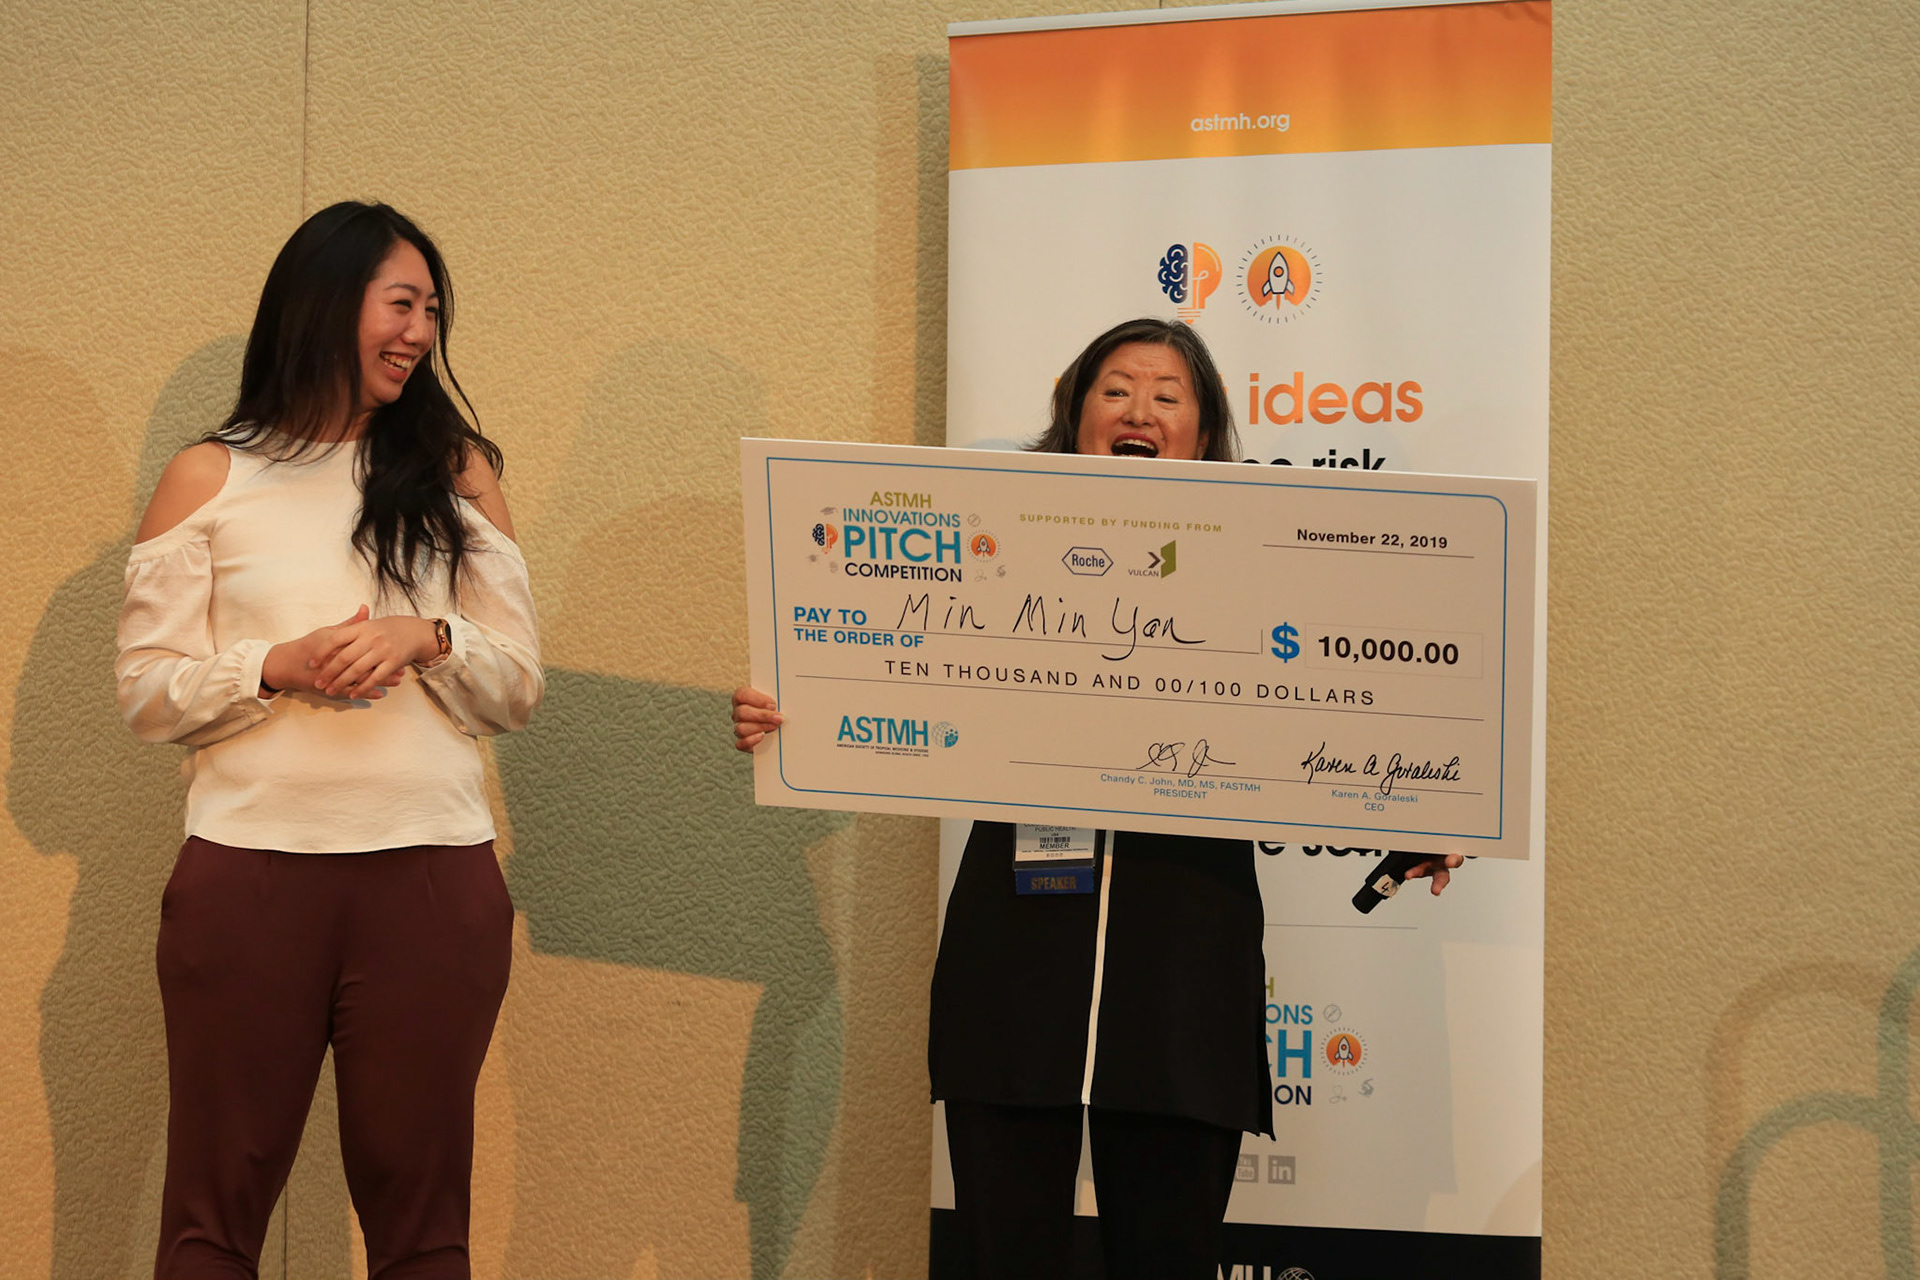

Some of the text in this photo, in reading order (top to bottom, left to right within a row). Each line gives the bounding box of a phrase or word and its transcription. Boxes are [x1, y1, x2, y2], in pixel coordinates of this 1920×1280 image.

[1190, 112, 1291, 132] astmh.org
[1249, 371, 1423, 425] ideas
[869, 490, 932, 510] ASTMH
[842, 507, 961, 528] INNOVATIONS
[1019, 513, 1222, 533] SUPPORTED BY FUNDING FROM
[843, 525, 962, 565] PITCH
[1297, 528, 1448, 549] November 22, 2019
[1071, 553, 1105, 568] Roche
[844, 562, 963, 583] COMPETITION
[1127, 568, 1160, 578] VULCAN
[793, 606, 868, 626] PAY TO
[896, 593, 985, 631] Min
[1012, 593, 1087, 639] Min
[794, 628, 925, 648] THE ORDER OF
[1270, 621, 1460, 665] $ 10,000.00
[885, 660, 1376, 706] TEN THOUSAND AND 00/100 DOLLARS
[837, 715, 930, 747] ASTMH
[1100, 773, 1136, 785] Chandy
[1138, 775, 1148, 784] C.
[1149, 776, 1176, 787] John,
[1220, 782, 1261, 793] FASTMH
[1153, 787, 1208, 800] PRESIDENT
[1331, 789, 1419, 803] Karen A. Goraleski
[1364, 802, 1386, 813] CEO
[1031, 876, 1076, 890] SPEAKER
